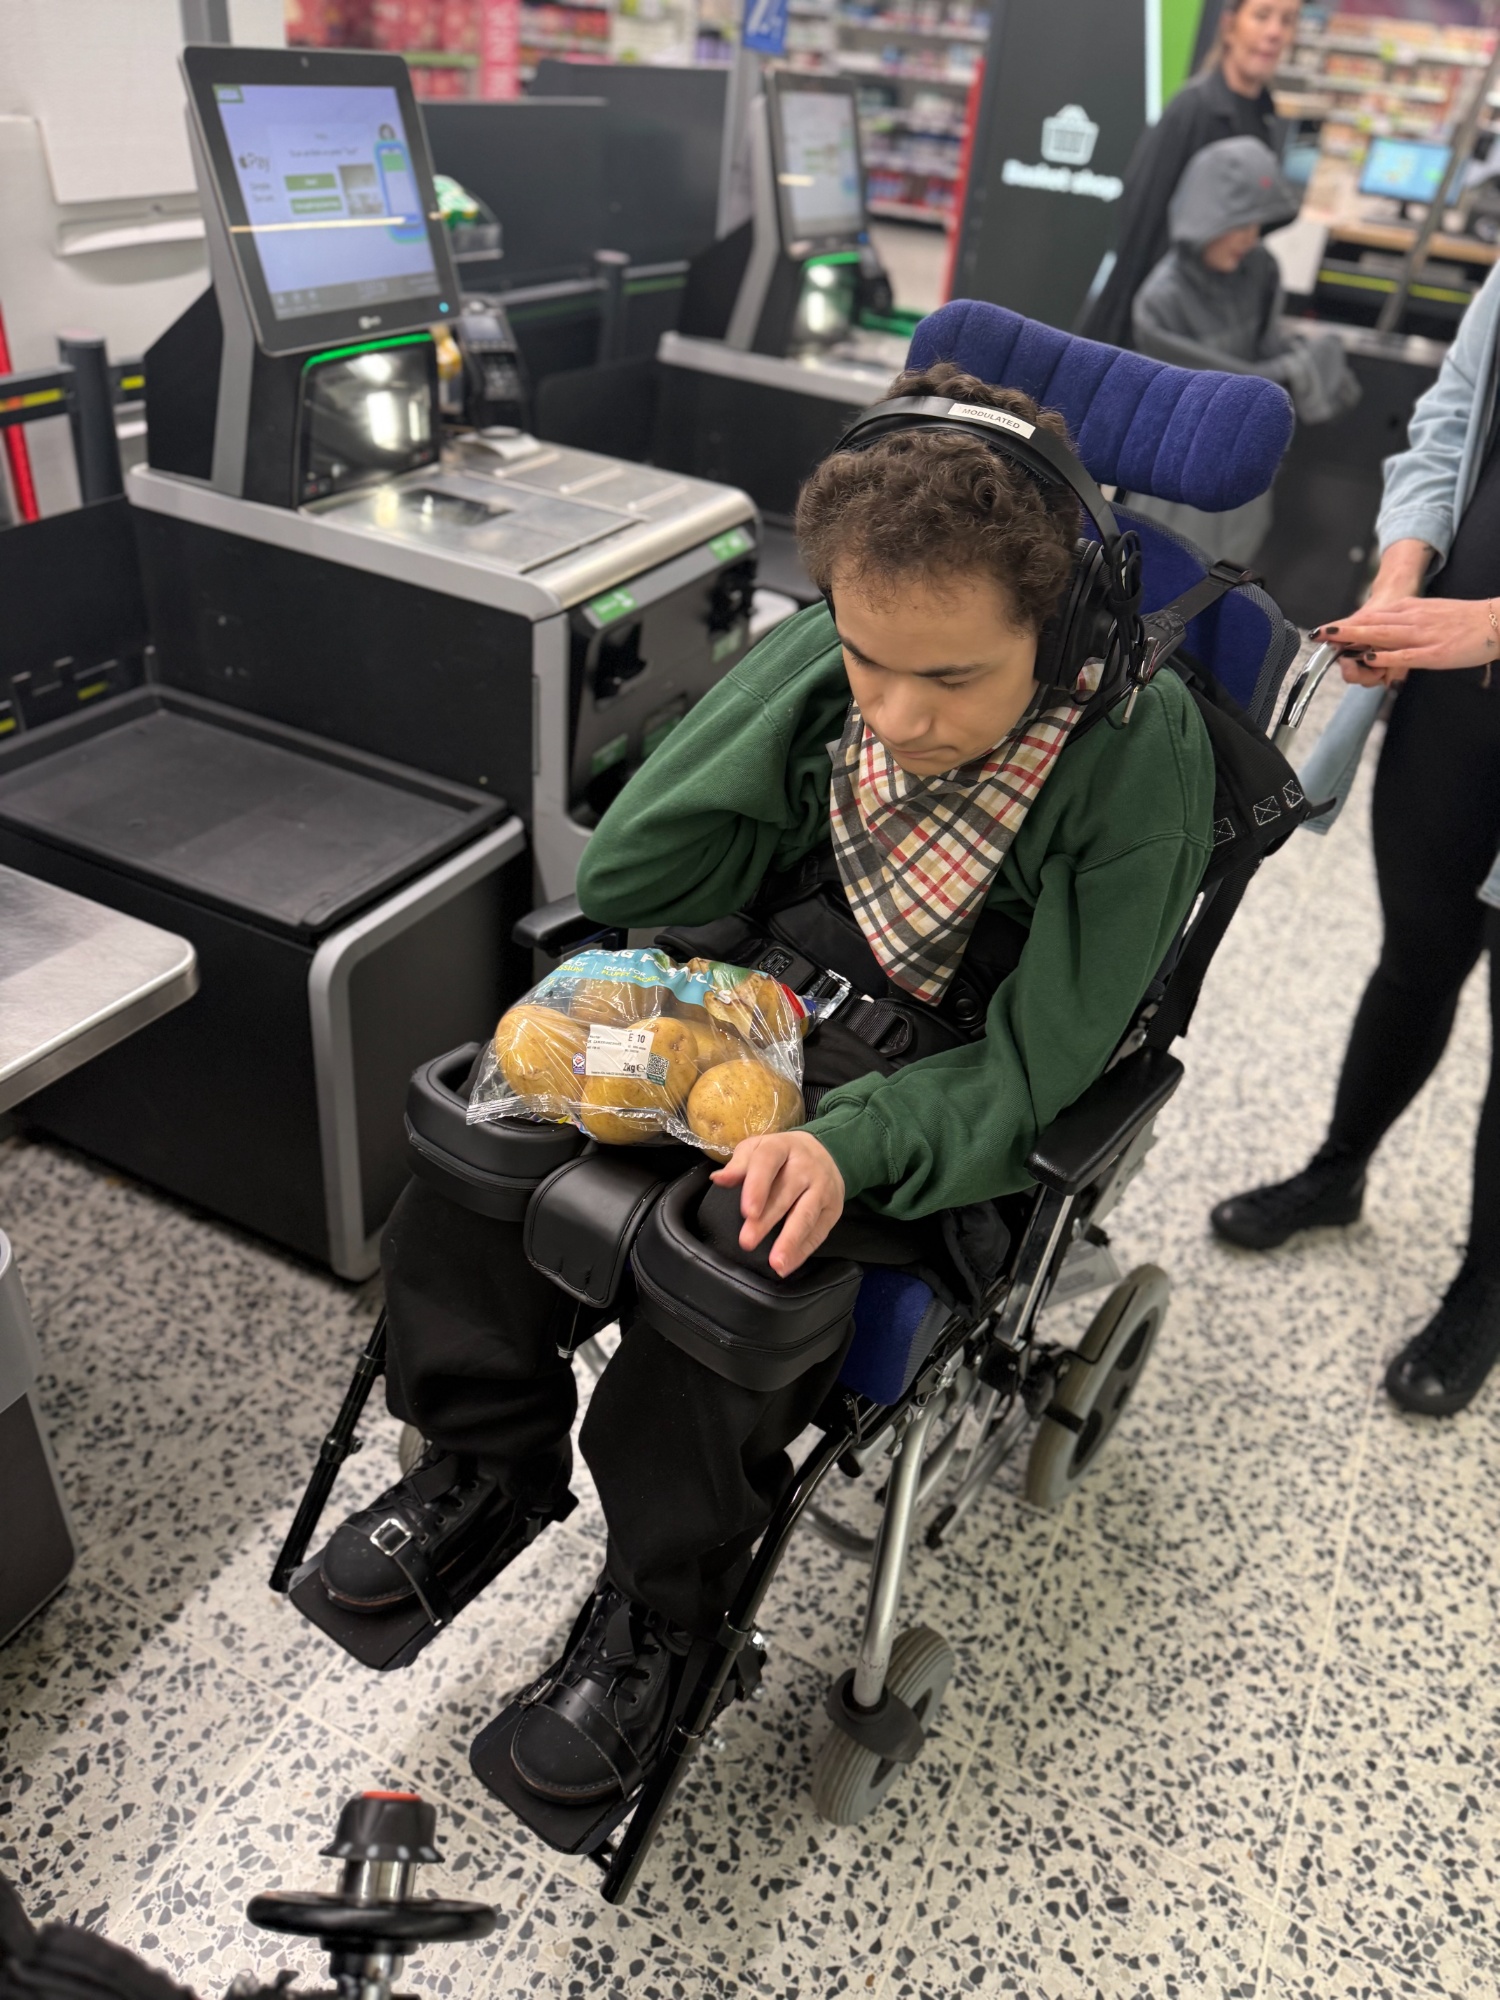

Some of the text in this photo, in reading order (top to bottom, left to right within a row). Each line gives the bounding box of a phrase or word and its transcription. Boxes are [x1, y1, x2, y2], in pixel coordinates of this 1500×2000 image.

[961, 408, 1020, 429] MODULATED
[601, 969, 630, 977] FLUFFY
[628, 966, 646, 977] FOR
[628, 1033, 646, 1043] E 10
[622, 1062, 636, 1073] 2kg
